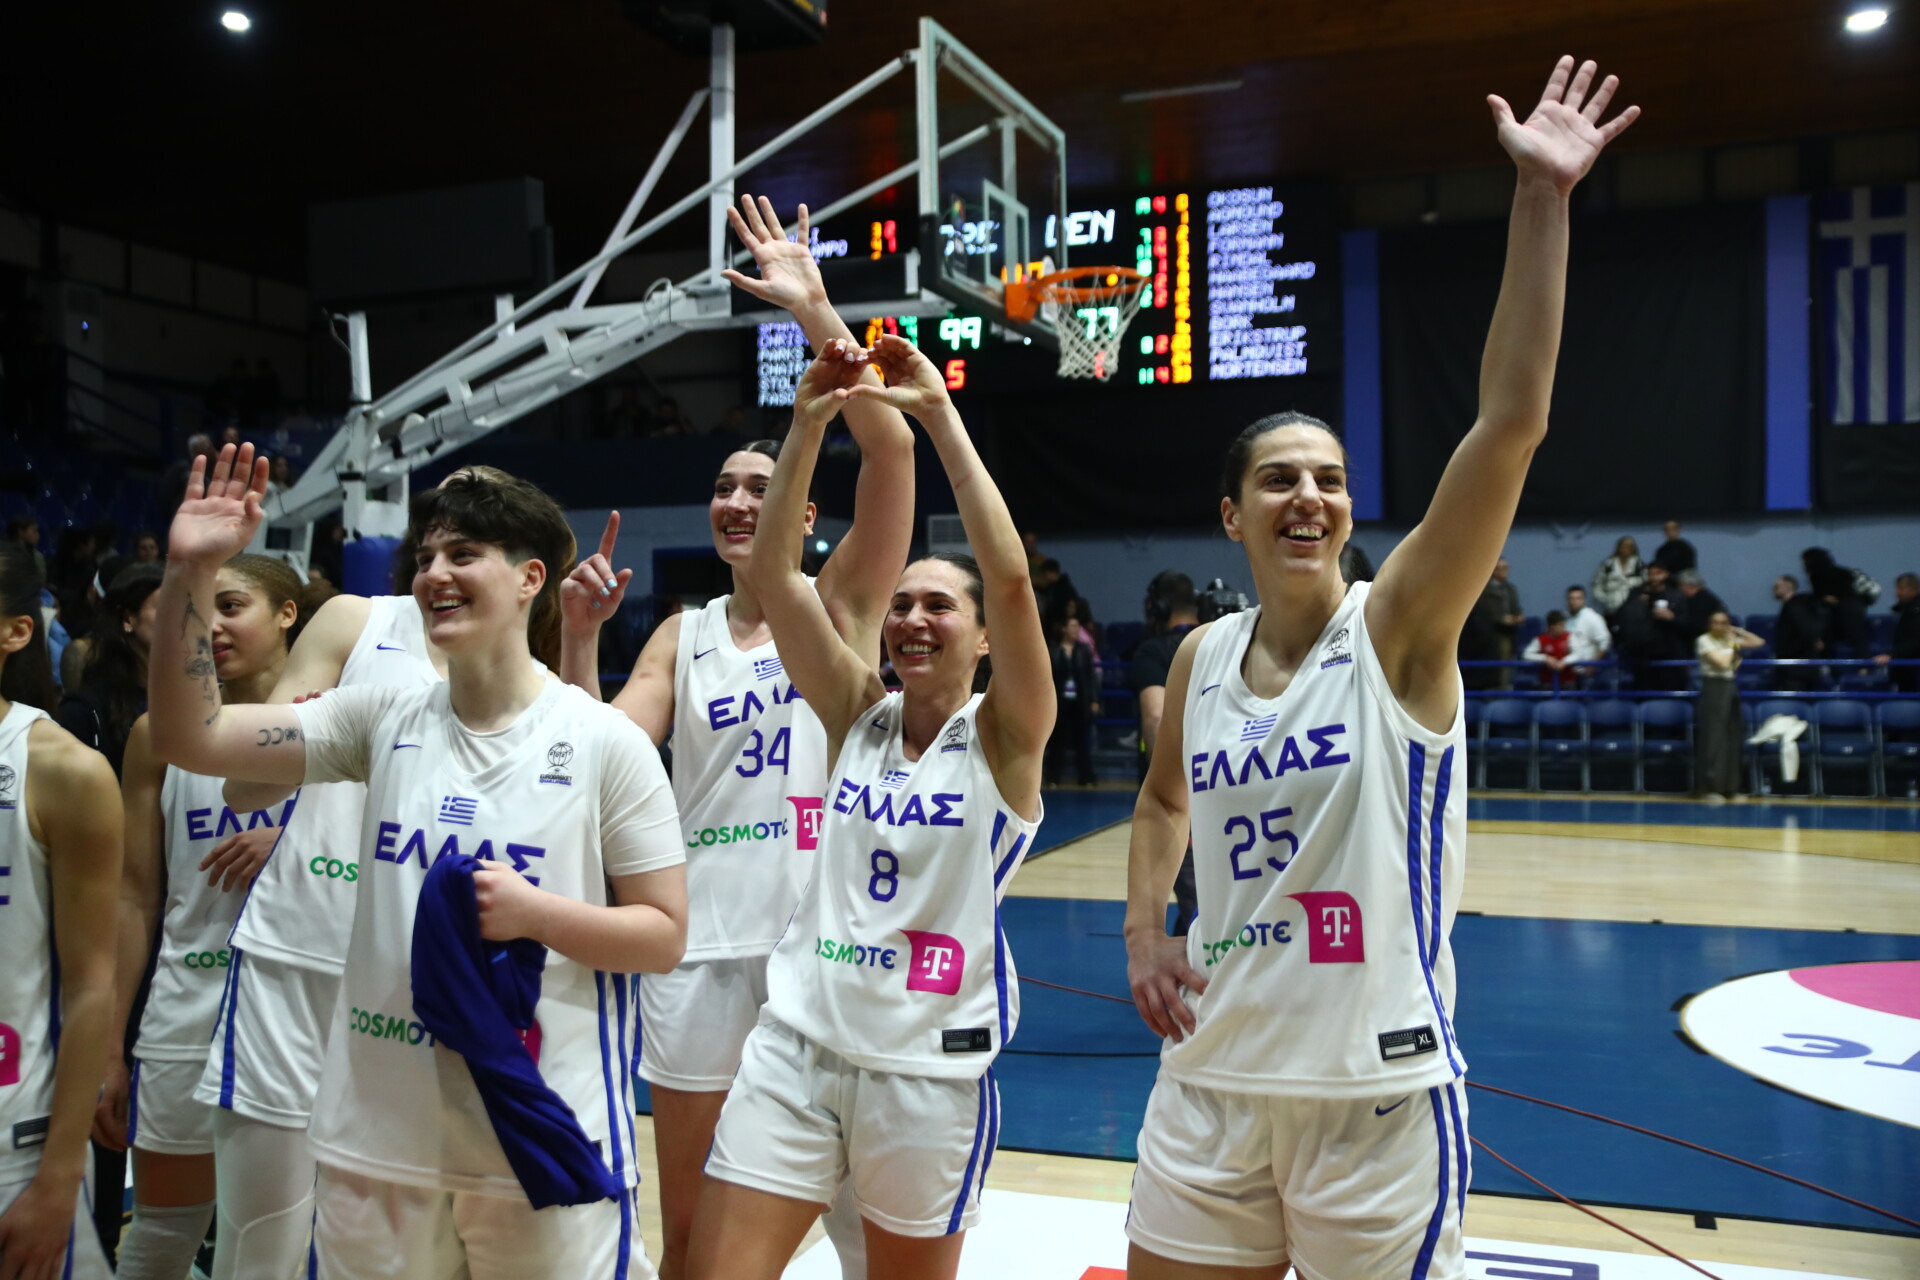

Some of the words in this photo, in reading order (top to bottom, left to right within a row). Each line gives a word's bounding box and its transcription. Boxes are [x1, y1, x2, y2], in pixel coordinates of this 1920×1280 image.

[940, 317, 982, 350] 99
[1077, 306, 1119, 340] 77
[946, 359, 966, 390] 5
[736, 727, 791, 777] 34
[1192, 723, 1351, 793] ΕΛΛΑΣ
[833, 777, 964, 827] ΕΛΛΑΣ
[1224, 806, 1299, 881] 25
[309, 855, 360, 882] COS
[868, 848, 899, 902] 8
[184, 950, 230, 969] COS
[815, 936, 898, 970] SMOTE
[1417, 1032, 1432, 1045] XL
